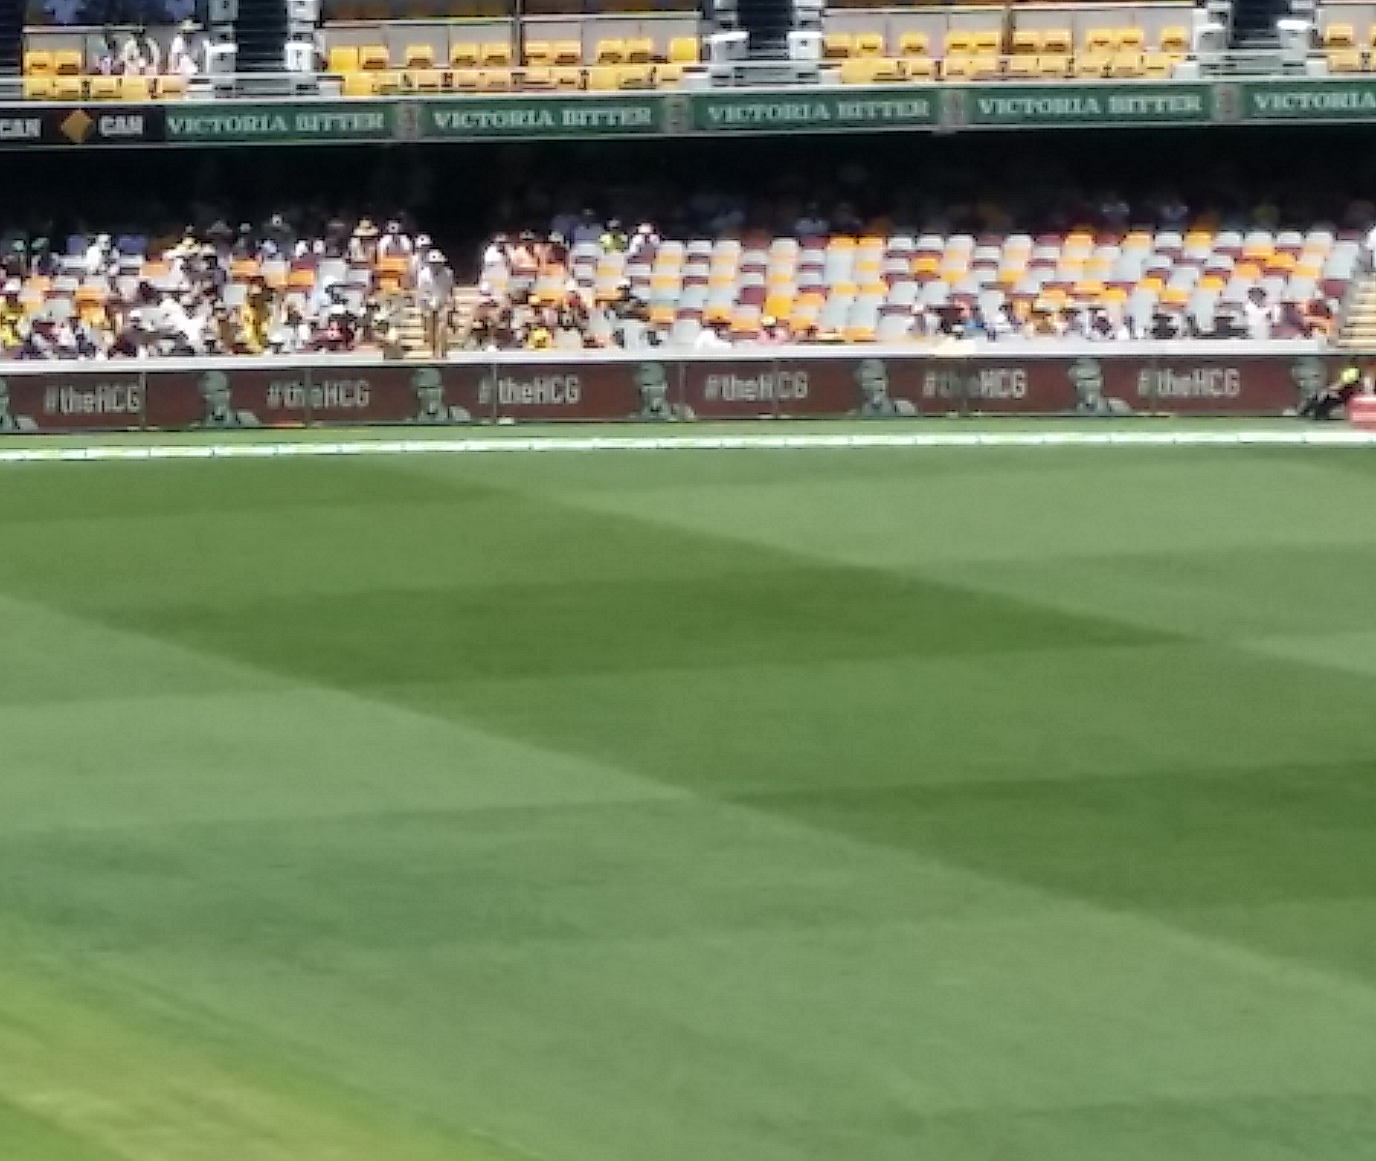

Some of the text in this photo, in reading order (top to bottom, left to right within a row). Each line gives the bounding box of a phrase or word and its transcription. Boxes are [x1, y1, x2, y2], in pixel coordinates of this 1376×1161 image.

[707, 99, 930, 122] VICTORIA BITTER
[977, 94, 1203, 116] VICTORIA BITTER
[1253, 91, 1376, 111] VICTORIA
[98, 114, 144, 135] CAN
[168, 111, 384, 134] VICTORIA BITTER
[433, 106, 652, 129] VICTORIA BITTER
